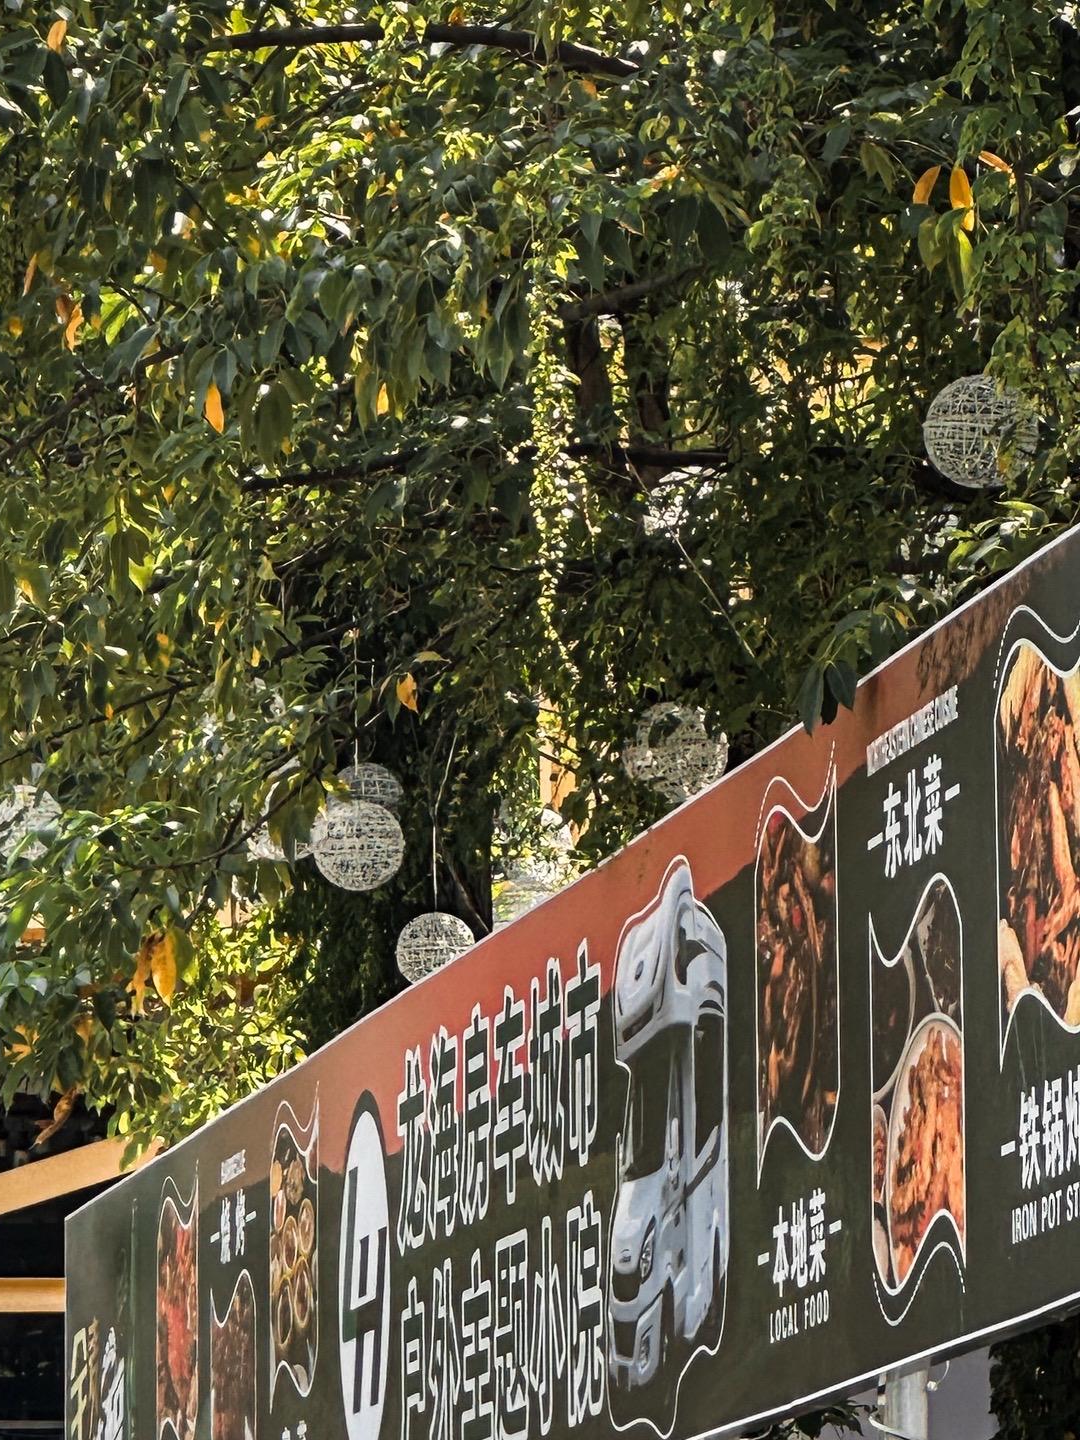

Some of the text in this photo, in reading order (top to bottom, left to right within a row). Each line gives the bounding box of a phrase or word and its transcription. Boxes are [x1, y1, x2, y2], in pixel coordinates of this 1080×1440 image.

[883, 753, 943, 878] 东北菜
[397, 937, 602, 1257] 龙海房车城市
[773, 1187, 826, 1298] 本地菜
[1011, 1200, 1037, 1245] IRON
[1041, 1189, 1062, 1232] POT
[770, 1289, 830, 1344] LOCAL FOOD
